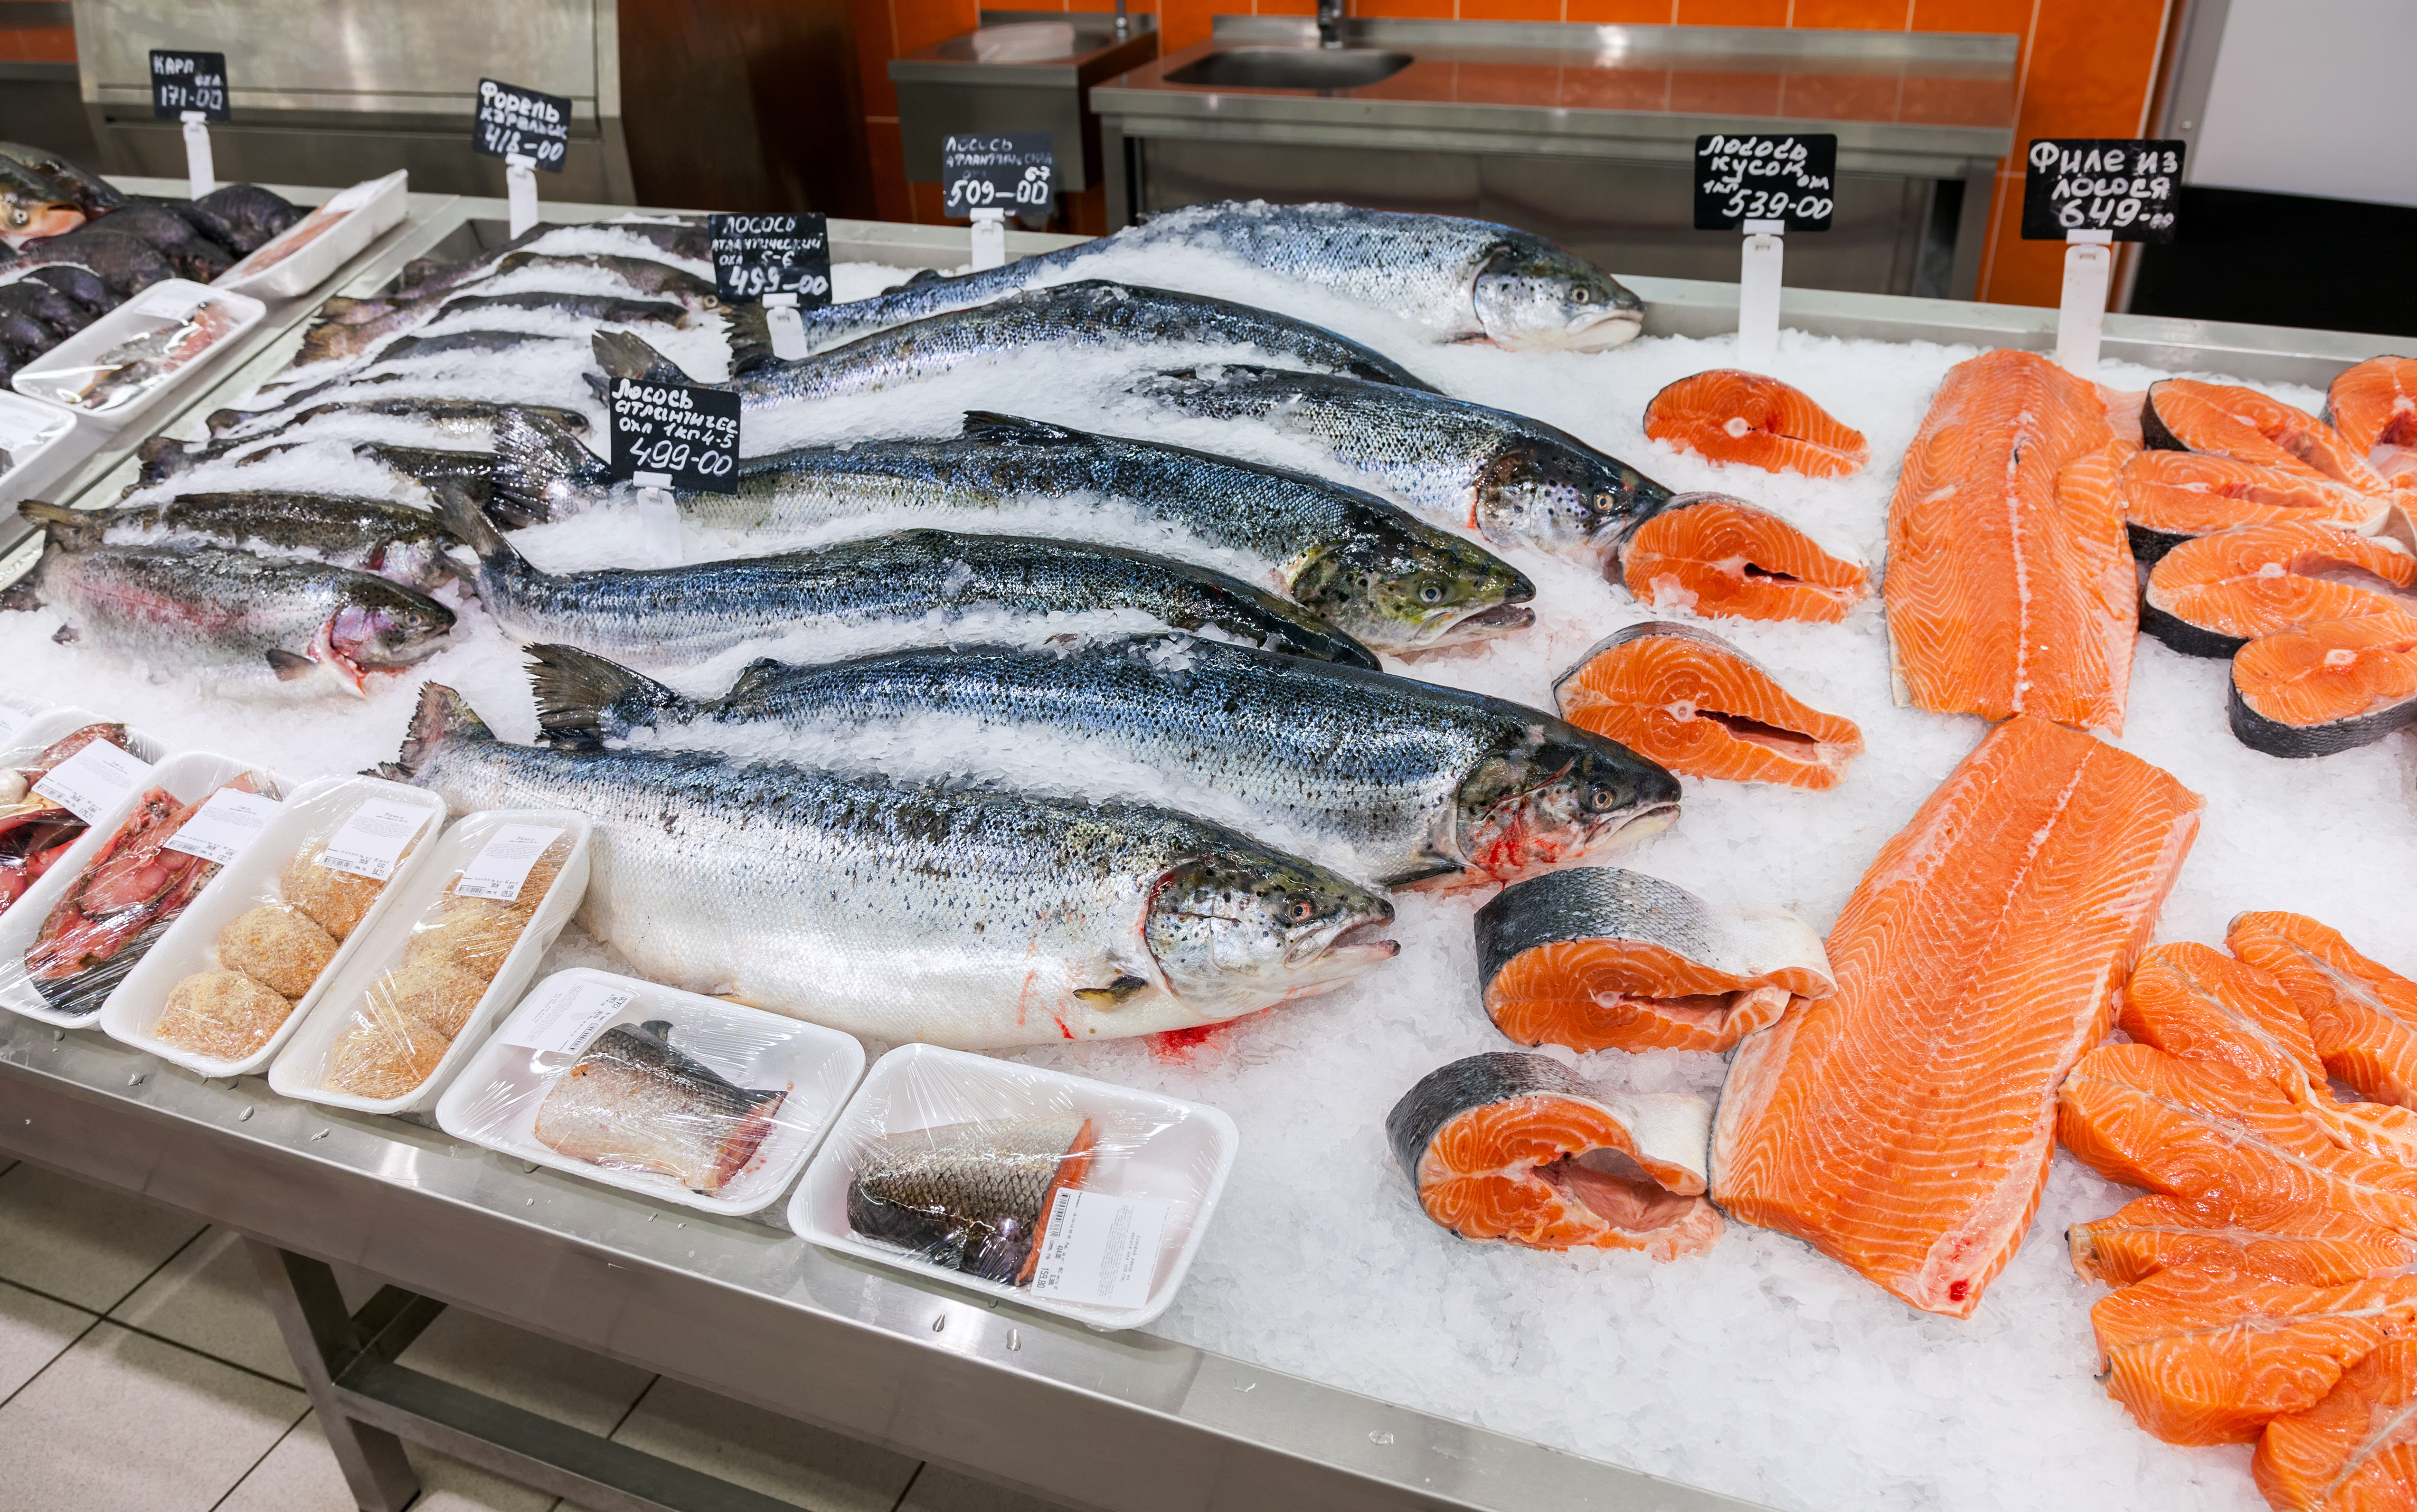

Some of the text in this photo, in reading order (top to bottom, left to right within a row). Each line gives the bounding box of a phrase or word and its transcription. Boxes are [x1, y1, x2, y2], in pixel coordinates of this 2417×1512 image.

[153, 54, 195, 75] КАРП
[480, 81, 560, 123] Форель
[2030, 142, 2178, 174] Филе из
[946, 179, 1048, 207] 509-00
[2051, 176, 2170, 201] лосося
[1721, 189, 1833, 219] 539-00
[728, 265, 829, 296] 499-00
[701, 429, 734, 448] 4-5
[629, 437, 733, 476] 499-00
[612, 996, 627, 1009] 124.20
[1036, 1267, 1049, 1288] 159.80
